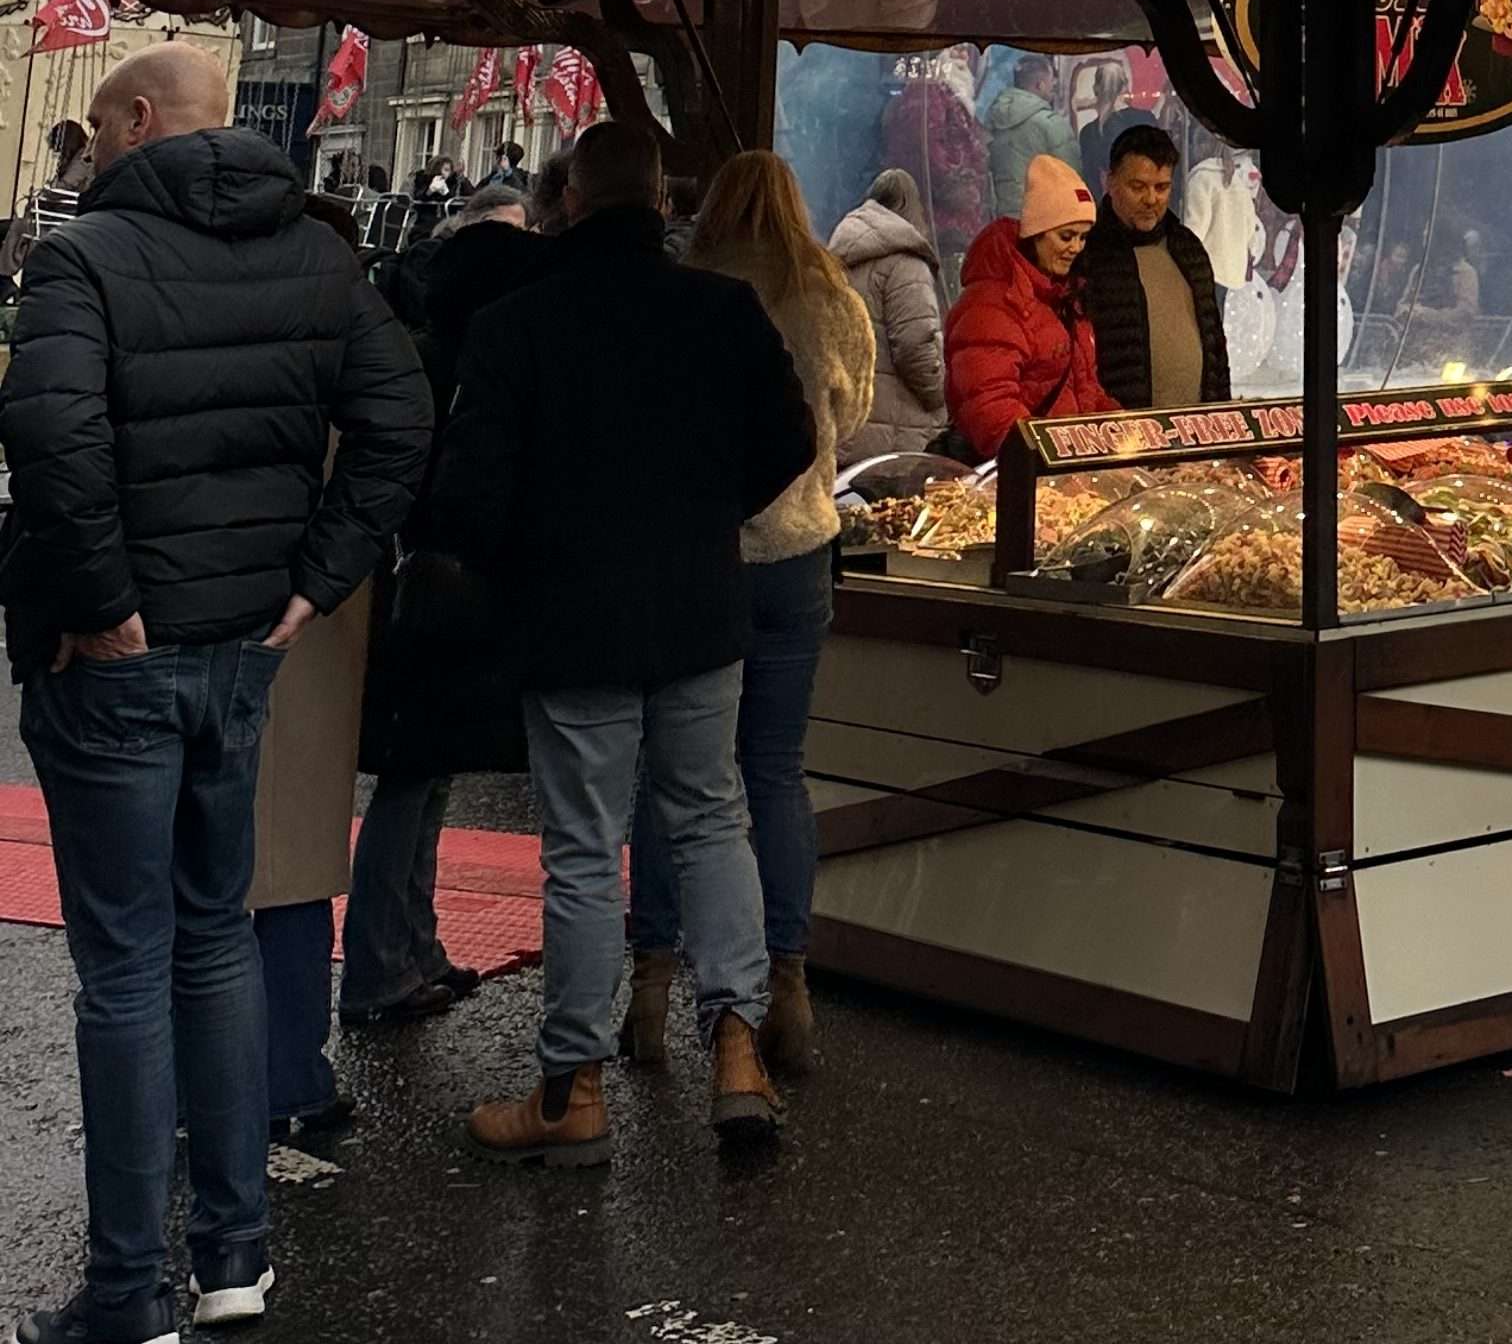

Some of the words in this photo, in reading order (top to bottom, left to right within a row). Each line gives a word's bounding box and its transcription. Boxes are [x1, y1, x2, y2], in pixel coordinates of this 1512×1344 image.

[1045, 409, 1256, 459] FINGER-FREE
[1341, 400, 1437, 427] Please
[1435, 396, 1486, 418] use
